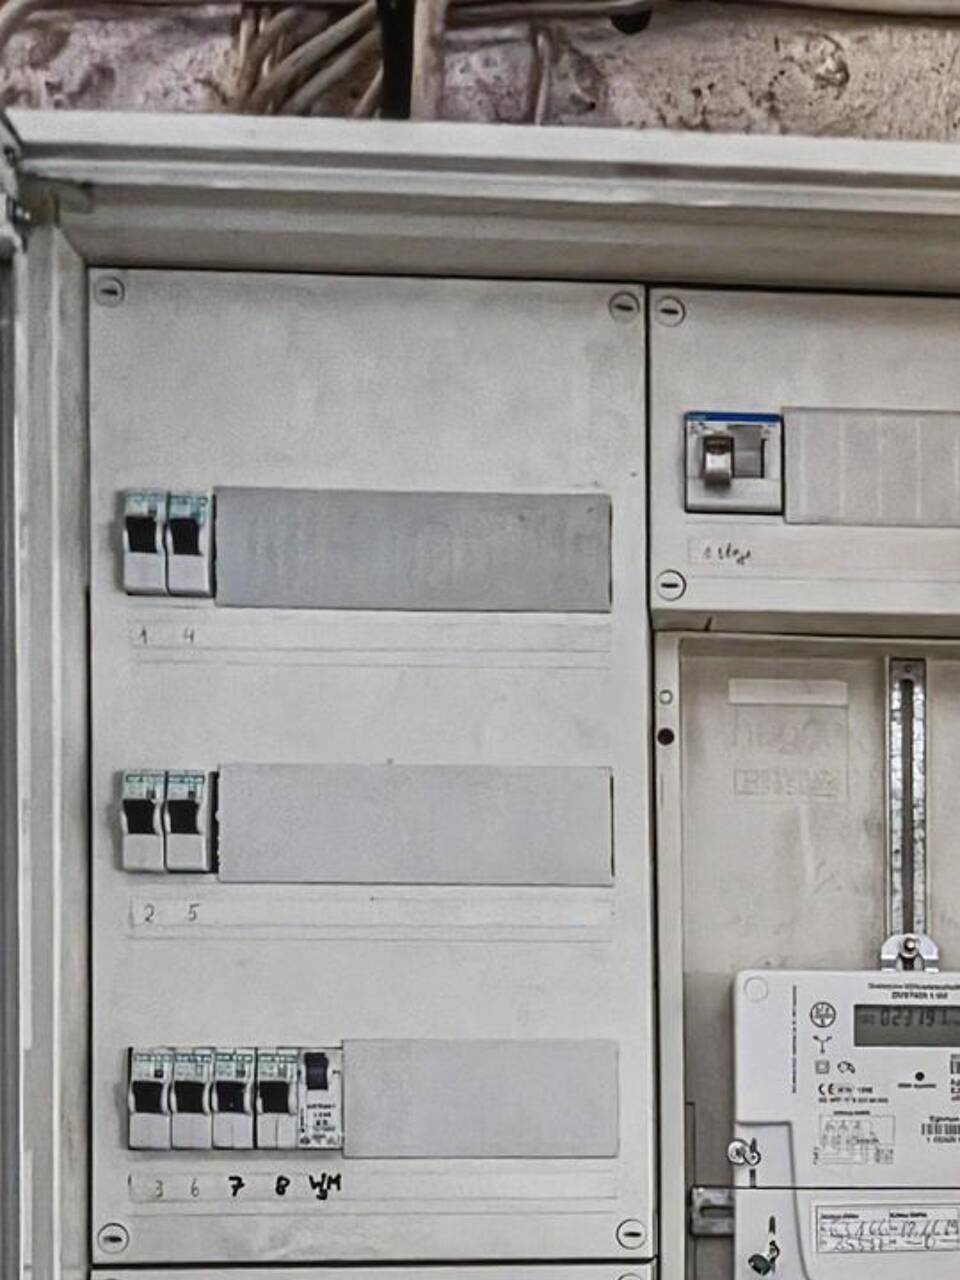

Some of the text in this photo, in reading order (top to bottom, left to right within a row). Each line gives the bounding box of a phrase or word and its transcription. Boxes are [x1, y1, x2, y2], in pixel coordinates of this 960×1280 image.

[144, 903, 200, 922] 2 5
[228, 1176, 245, 1197] 7
[275, 1175, 291, 1196] 8
